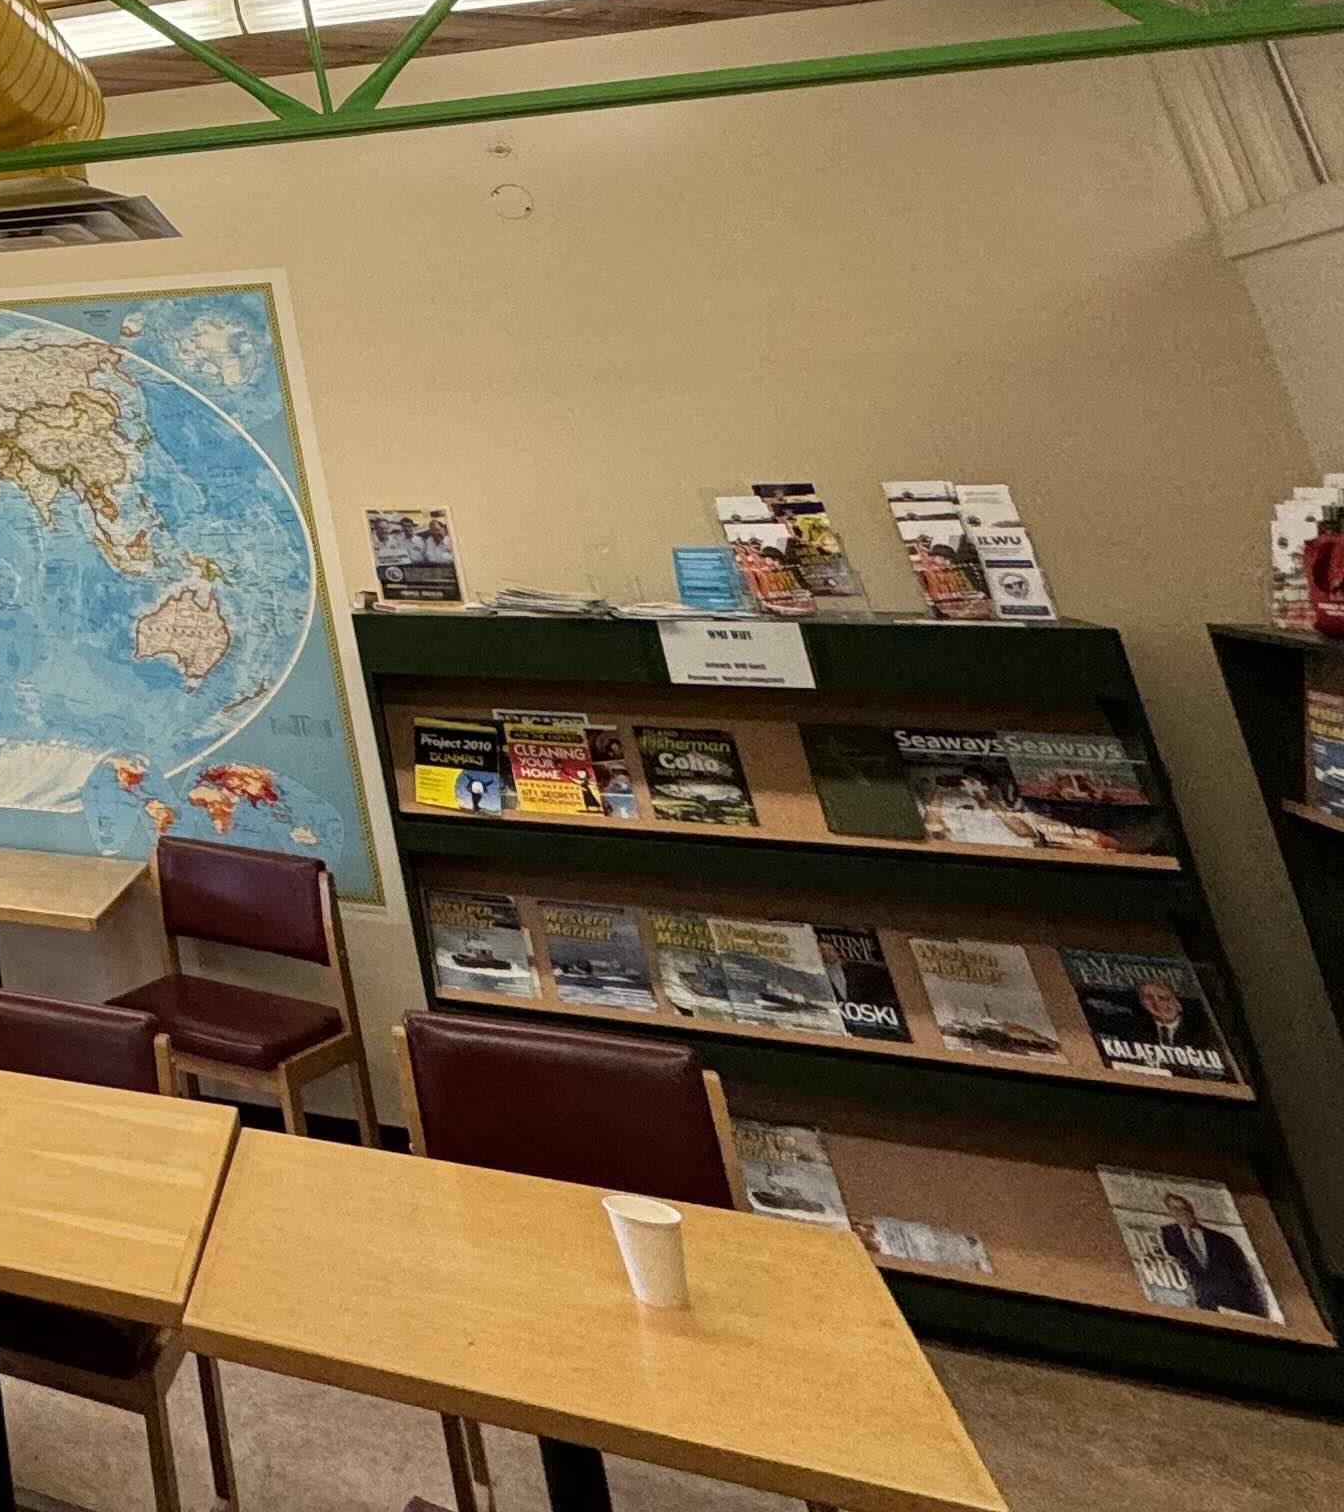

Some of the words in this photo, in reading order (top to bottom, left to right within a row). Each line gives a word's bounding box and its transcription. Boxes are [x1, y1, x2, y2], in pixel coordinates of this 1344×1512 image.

[420, 734, 462, 750] Project
[463, 739, 493, 753] 2010
[894, 730, 1002, 755] Seaways
[1003, 735, 1123, 760] Seaways
[514, 743, 587, 761] CLEANING
[518, 757, 555, 769] YOUR
[520, 767, 561, 780] HOME
